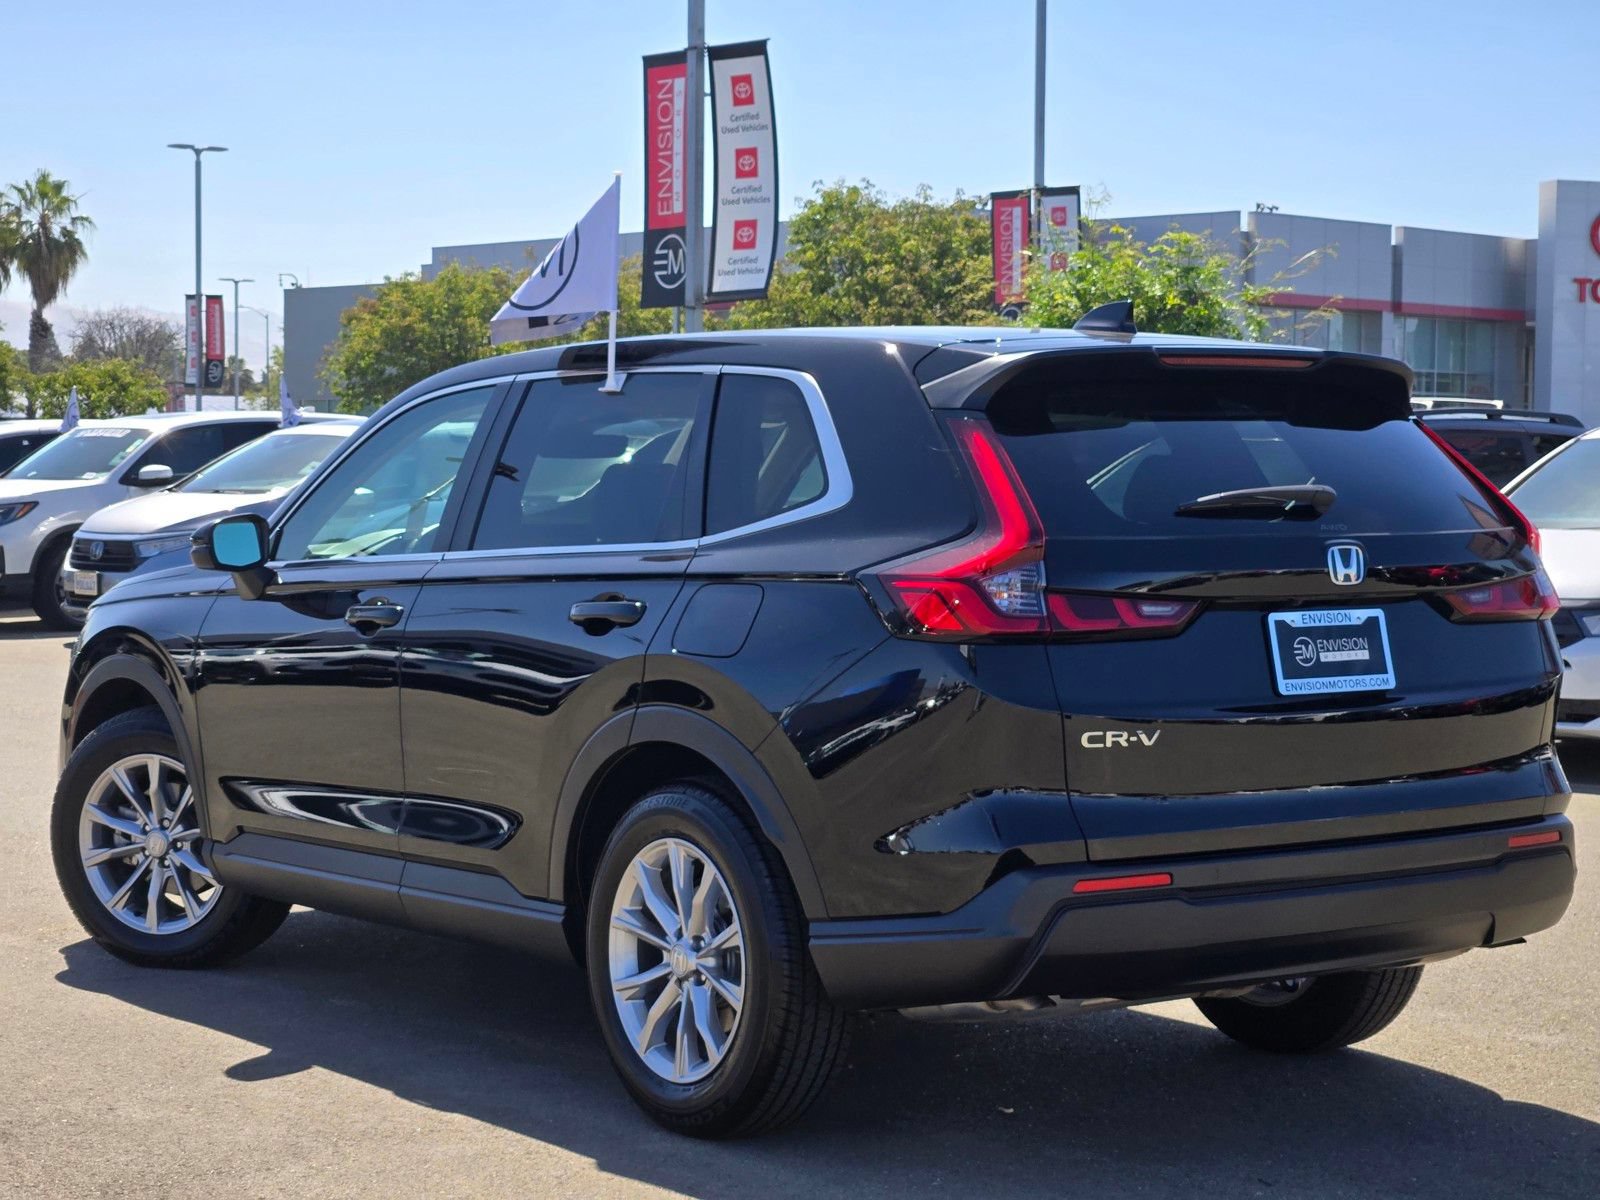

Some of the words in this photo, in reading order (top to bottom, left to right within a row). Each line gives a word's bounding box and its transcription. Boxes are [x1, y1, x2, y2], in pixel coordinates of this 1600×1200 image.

[730, 111, 760, 122] Certified
[721, 126, 740, 134] Used
[741, 123, 768, 133] Vehicles
[657, 79, 673, 216] ENVISION
[731, 184, 762, 194] Certified
[721, 197, 740, 206] Used
[742, 195, 771, 205] Vehicles
[728, 255, 758, 265] Certified
[718, 267, 736, 277] Used
[738, 265, 765, 275] Vehicles
[1301, 612, 1352, 625] ENVISION
[1316, 637, 1369, 652] ENVISION
[1285, 677, 1390, 692] ENVISIONMOTORS.COM
[1080, 729, 1161, 749] CR-V
